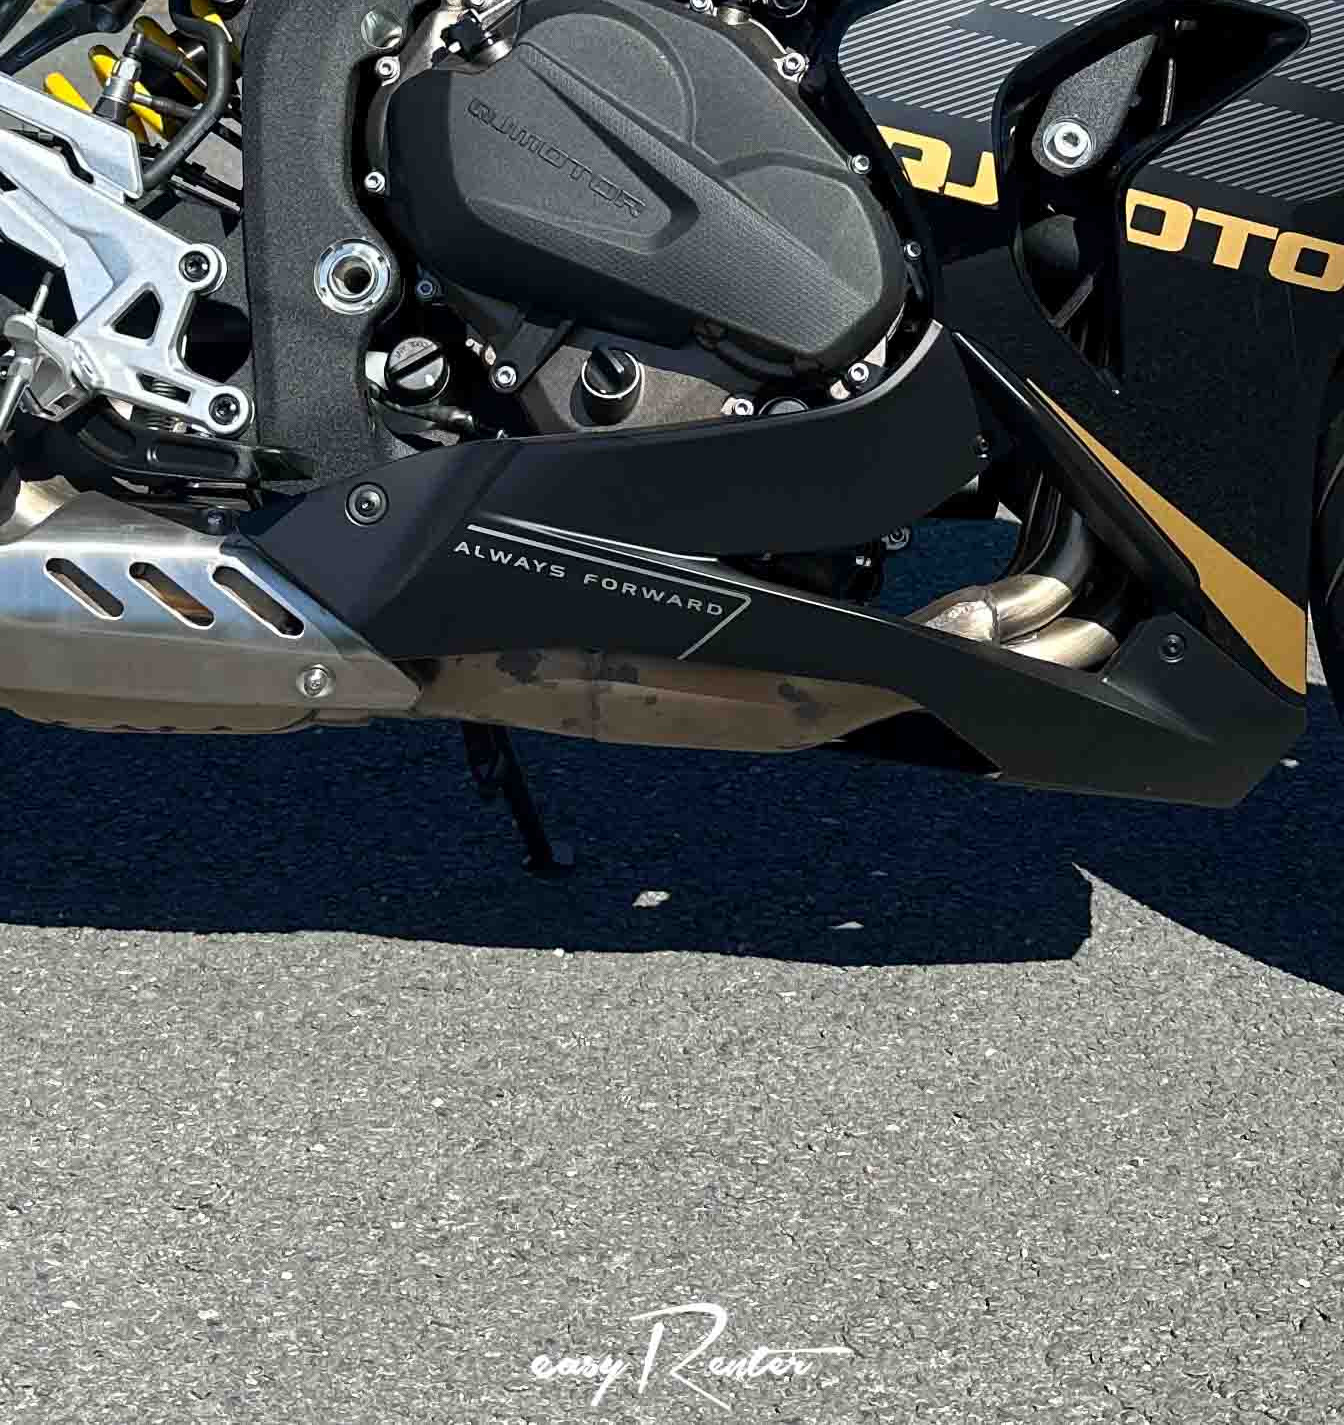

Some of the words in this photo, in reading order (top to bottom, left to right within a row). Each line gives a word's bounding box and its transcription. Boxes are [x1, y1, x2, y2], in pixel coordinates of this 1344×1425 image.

[465, 97, 647, 219] QJMOTOR
[453, 541, 566, 578] ALWAYS
[583, 574, 724, 616] FORWARD
